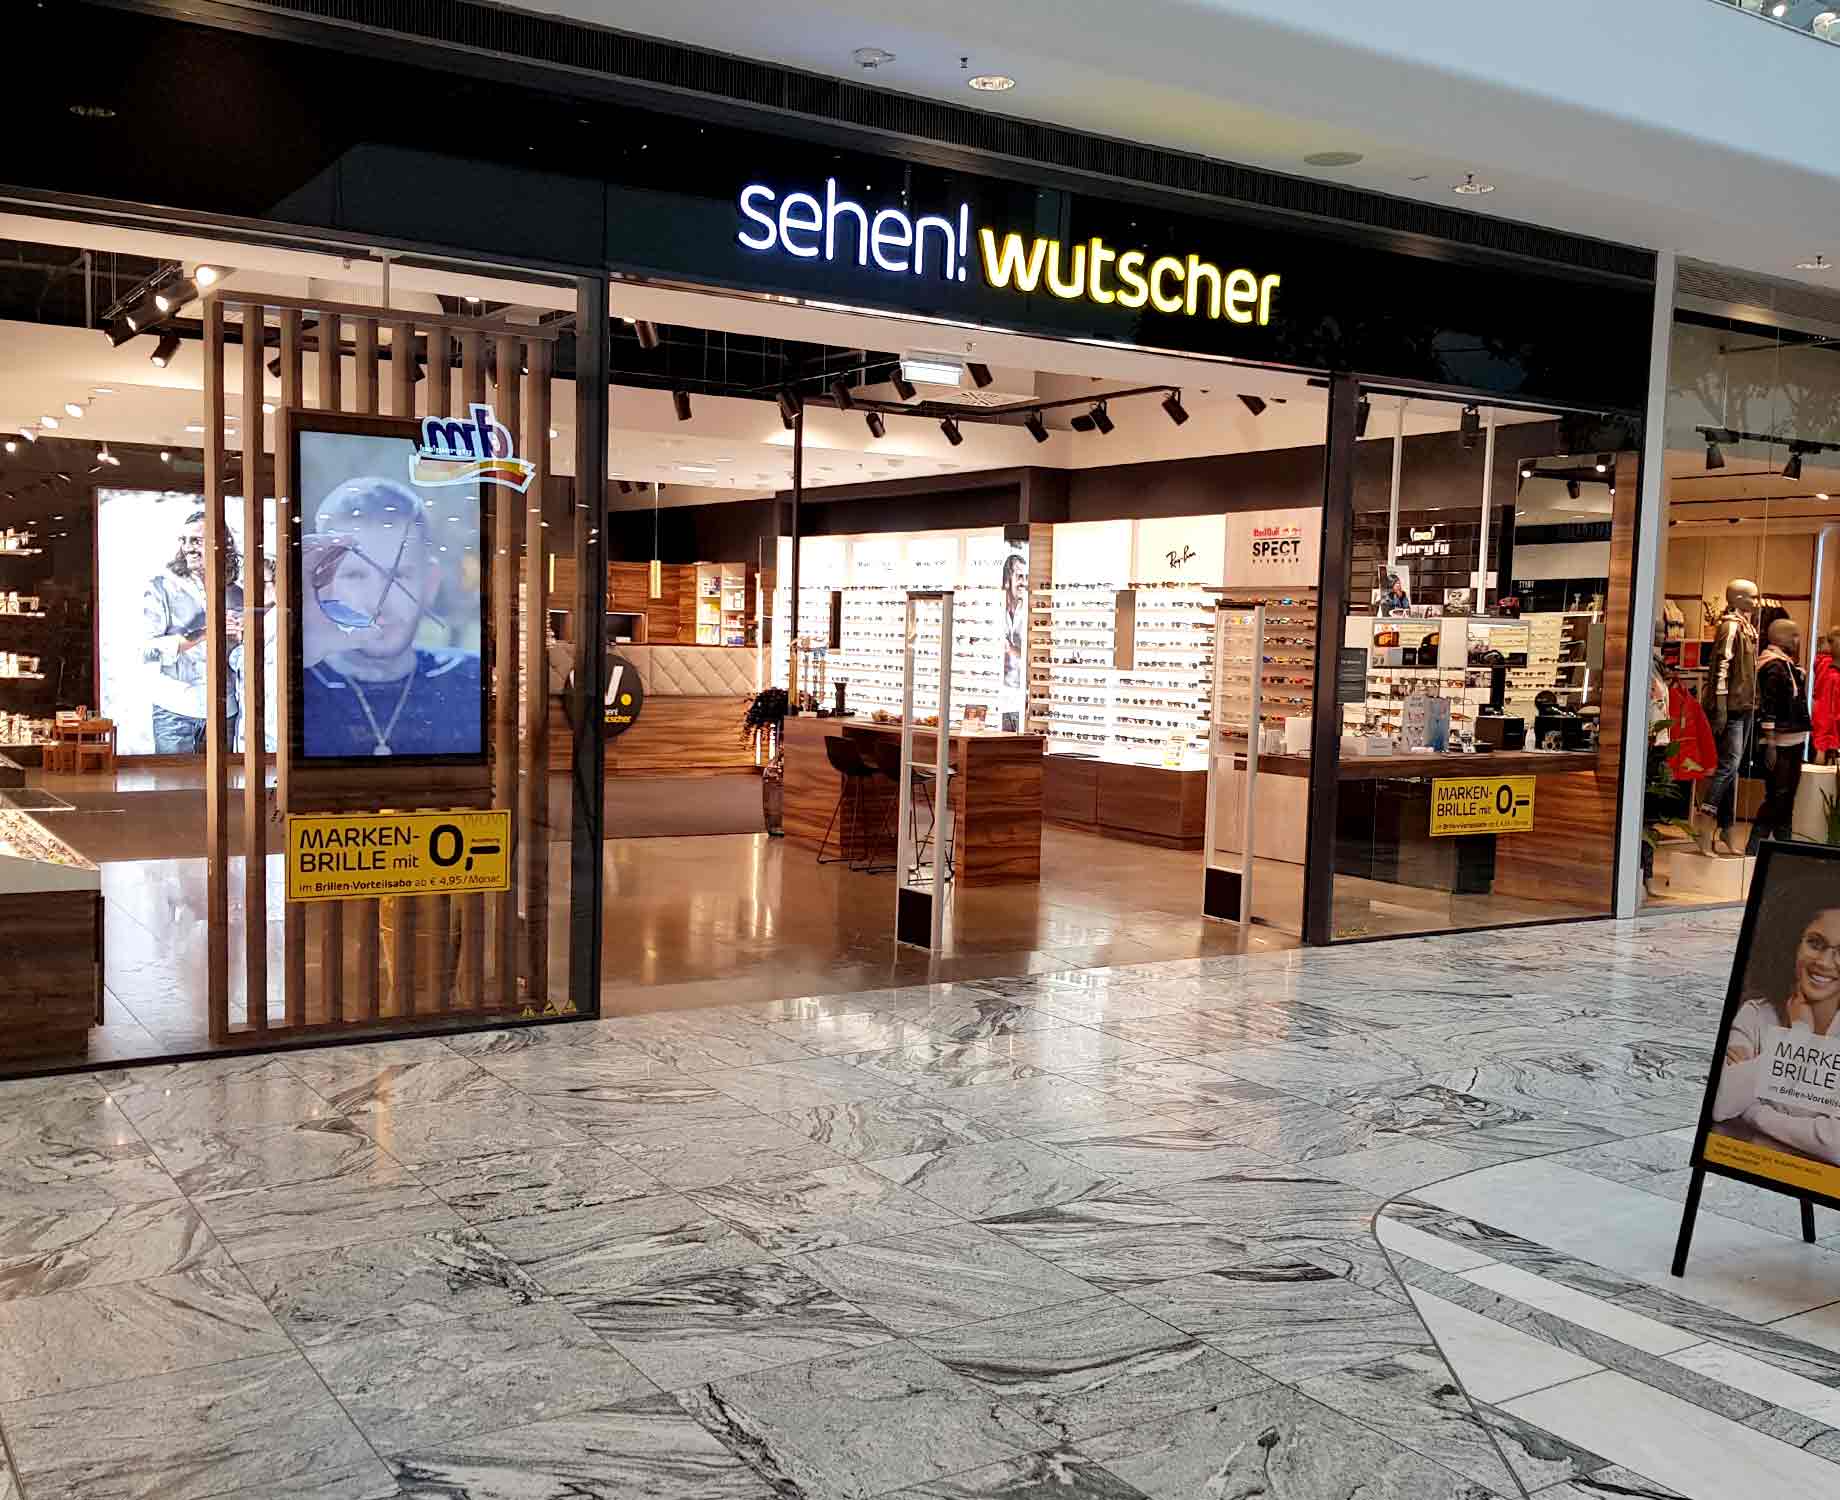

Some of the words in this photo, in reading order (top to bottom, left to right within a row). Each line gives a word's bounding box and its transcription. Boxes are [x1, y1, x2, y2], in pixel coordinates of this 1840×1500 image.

[738, 177, 969, 282] sehen!
[978, 228, 1281, 325] wutscher
[1252, 540, 1301, 557] SPECT
[1396, 543, 1450, 557] gloryfy
[1438, 785, 1493, 801] MARKEN-
[1437, 803, 1477, 817] BRILLE
[300, 826, 421, 849] MARKEN-
[300, 850, 386, 873] BRILLE
[393, 854, 420, 869] mit
[315, 878, 412, 892] Brillen-Vorteilsabo
[1771, 1060, 1836, 1090] BRILLE
